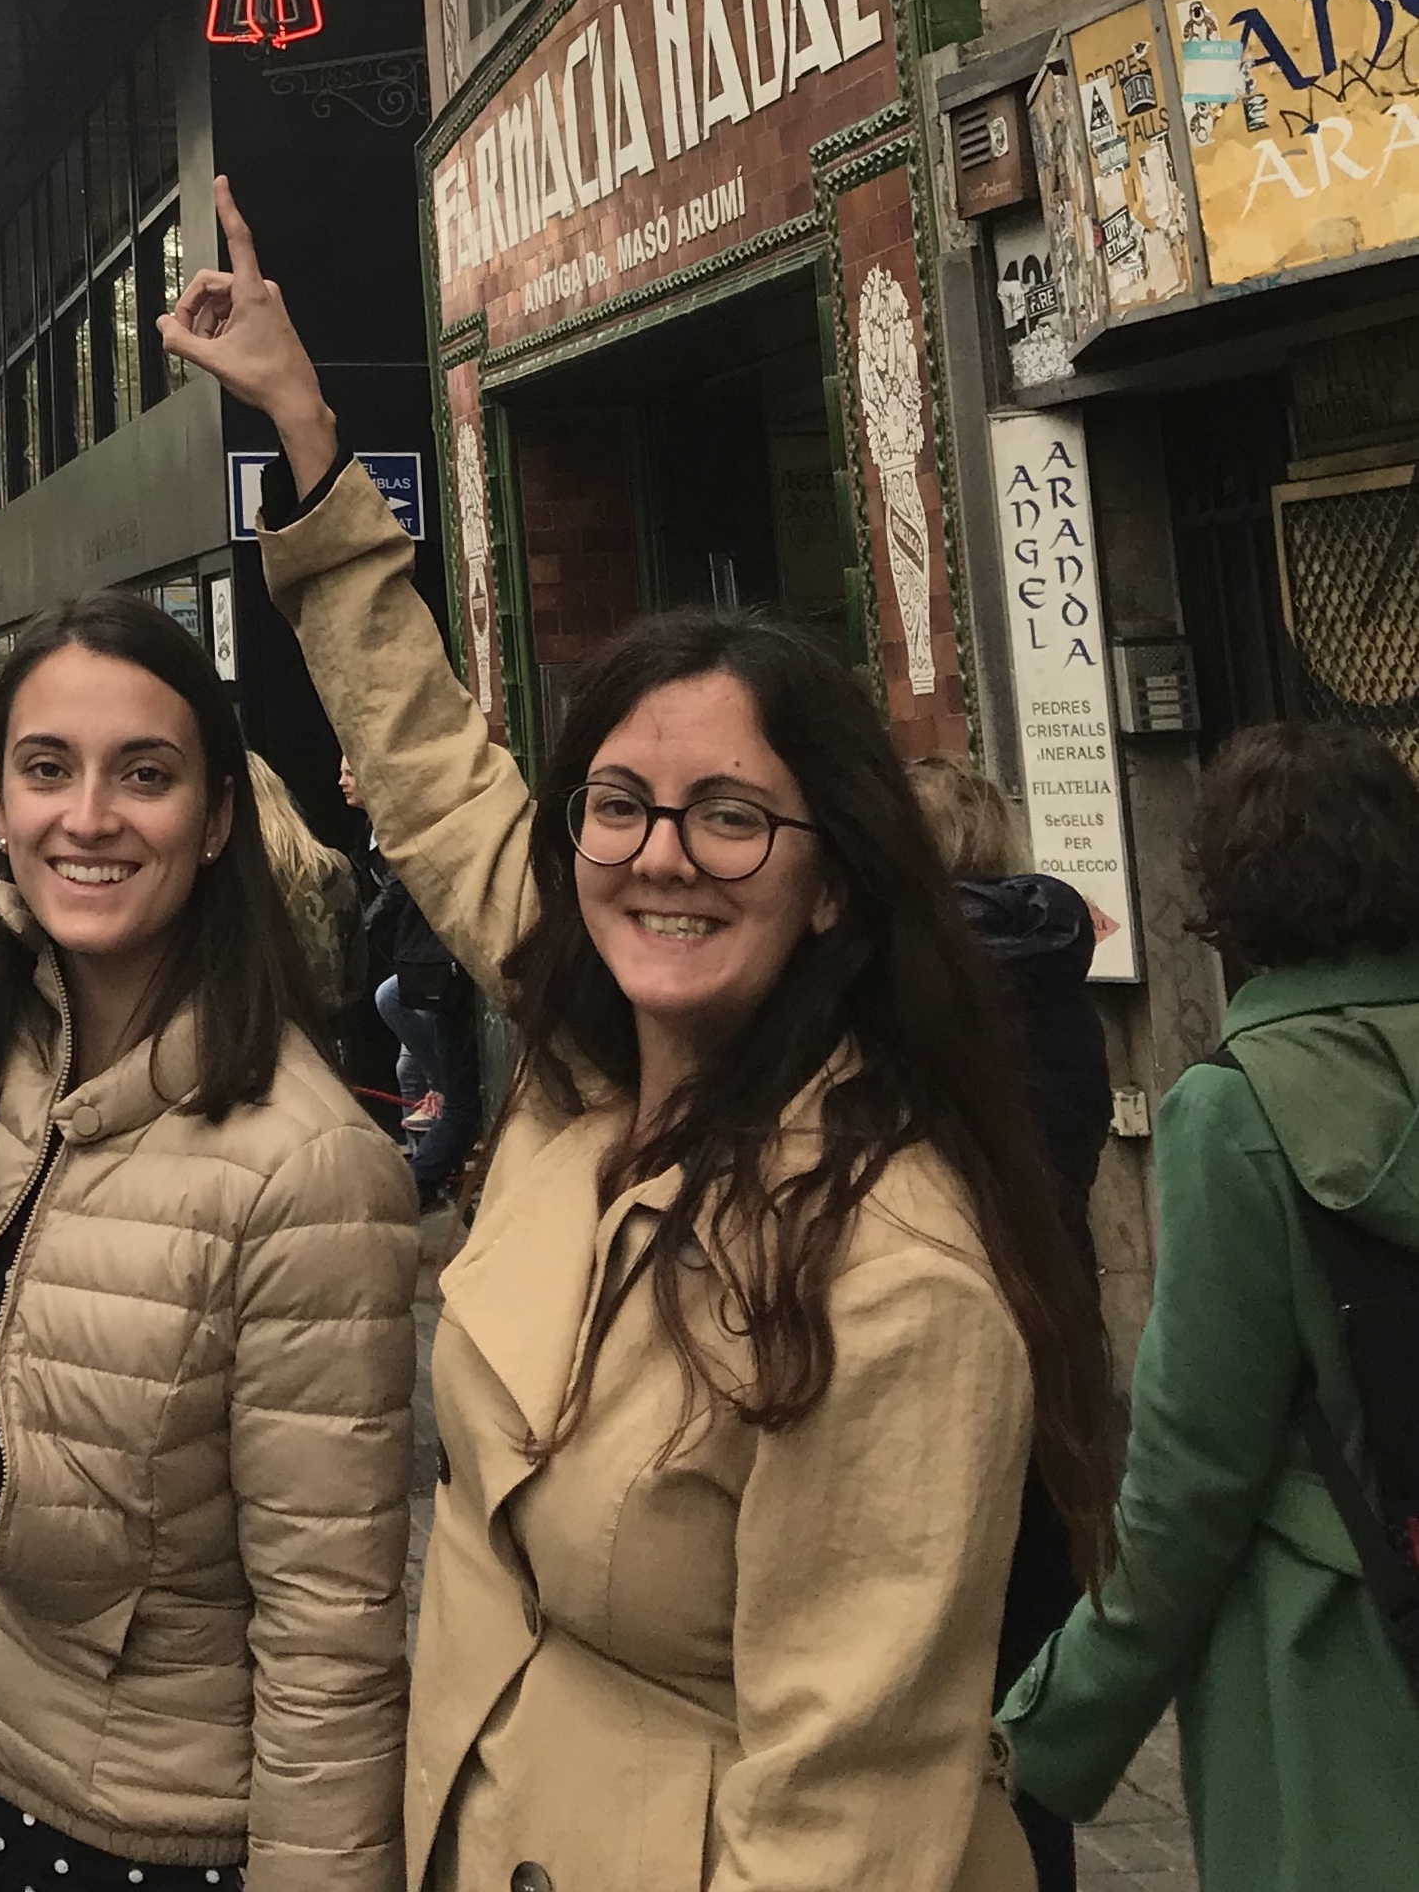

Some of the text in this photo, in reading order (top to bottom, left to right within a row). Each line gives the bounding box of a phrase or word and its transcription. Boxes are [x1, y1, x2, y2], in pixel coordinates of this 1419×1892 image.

[524, 258, 584, 316] ANTIGA
[616, 206, 671, 273] MASÓ
[676, 165, 746, 246] ARUMÍ
[373, 477, 411, 490] BLAS
[1005, 465, 1048, 650] ANGEL
[1041, 441, 1098, 669] ARANDA
[1032, 700, 1092, 716] PEDRES
[1026, 722, 1106, 738] CRISTALLS
[1036, 745, 1106, 761] INERALS
[1032, 779, 1112, 795] FILATELIA
[1064, 836, 1092, 850] PER
[1040, 859, 1118, 873] COLLECCIO
